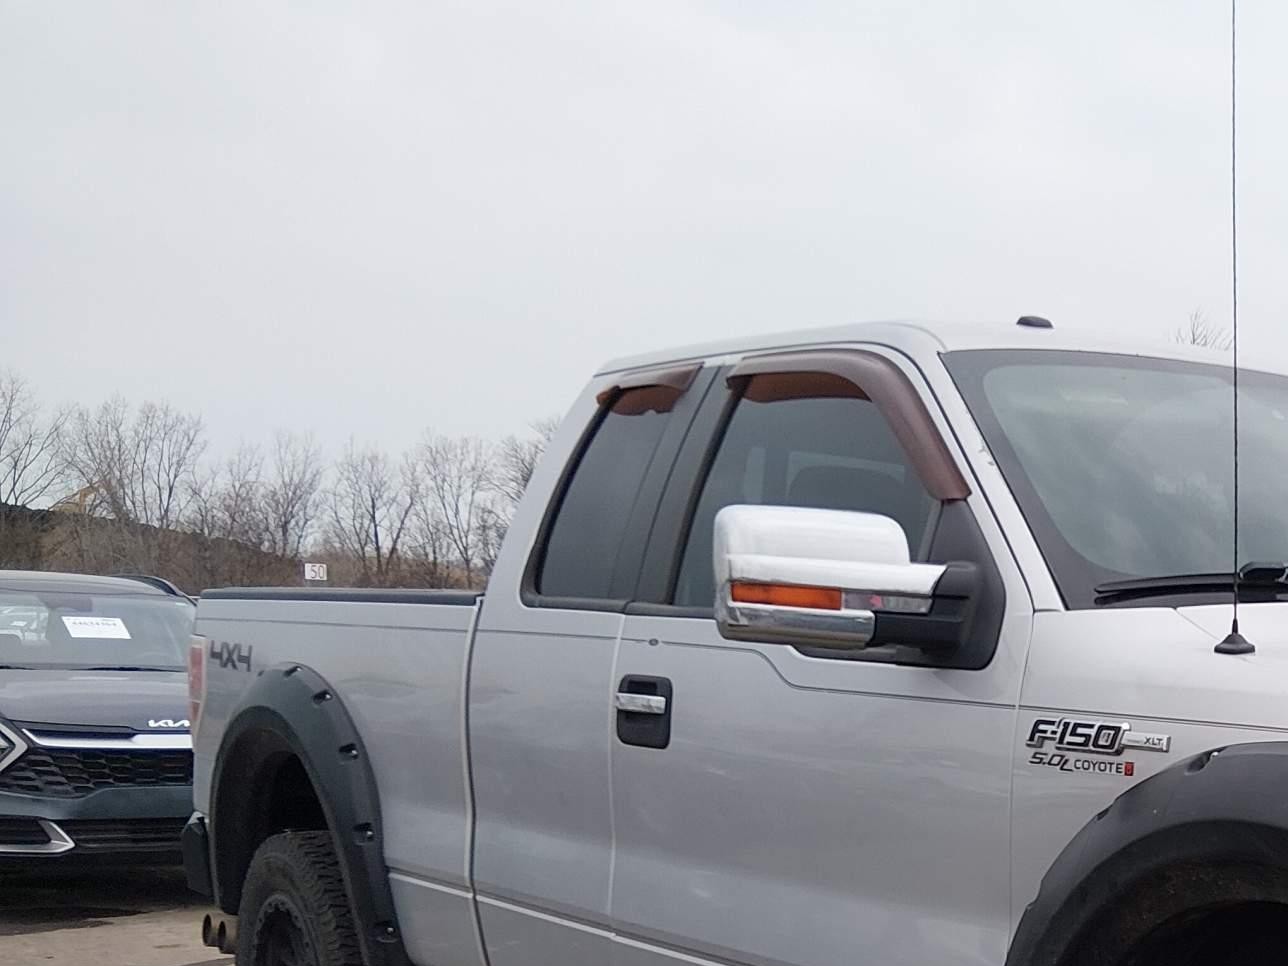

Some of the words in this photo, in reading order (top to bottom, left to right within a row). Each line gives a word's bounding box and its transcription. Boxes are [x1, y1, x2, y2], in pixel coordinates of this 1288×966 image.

[311, 564, 325, 579] 50
[1143, 736, 1164, 746] XLT
[1029, 751, 1074, 773] 5.0L
[1074, 759, 1123, 774] COYOTE
